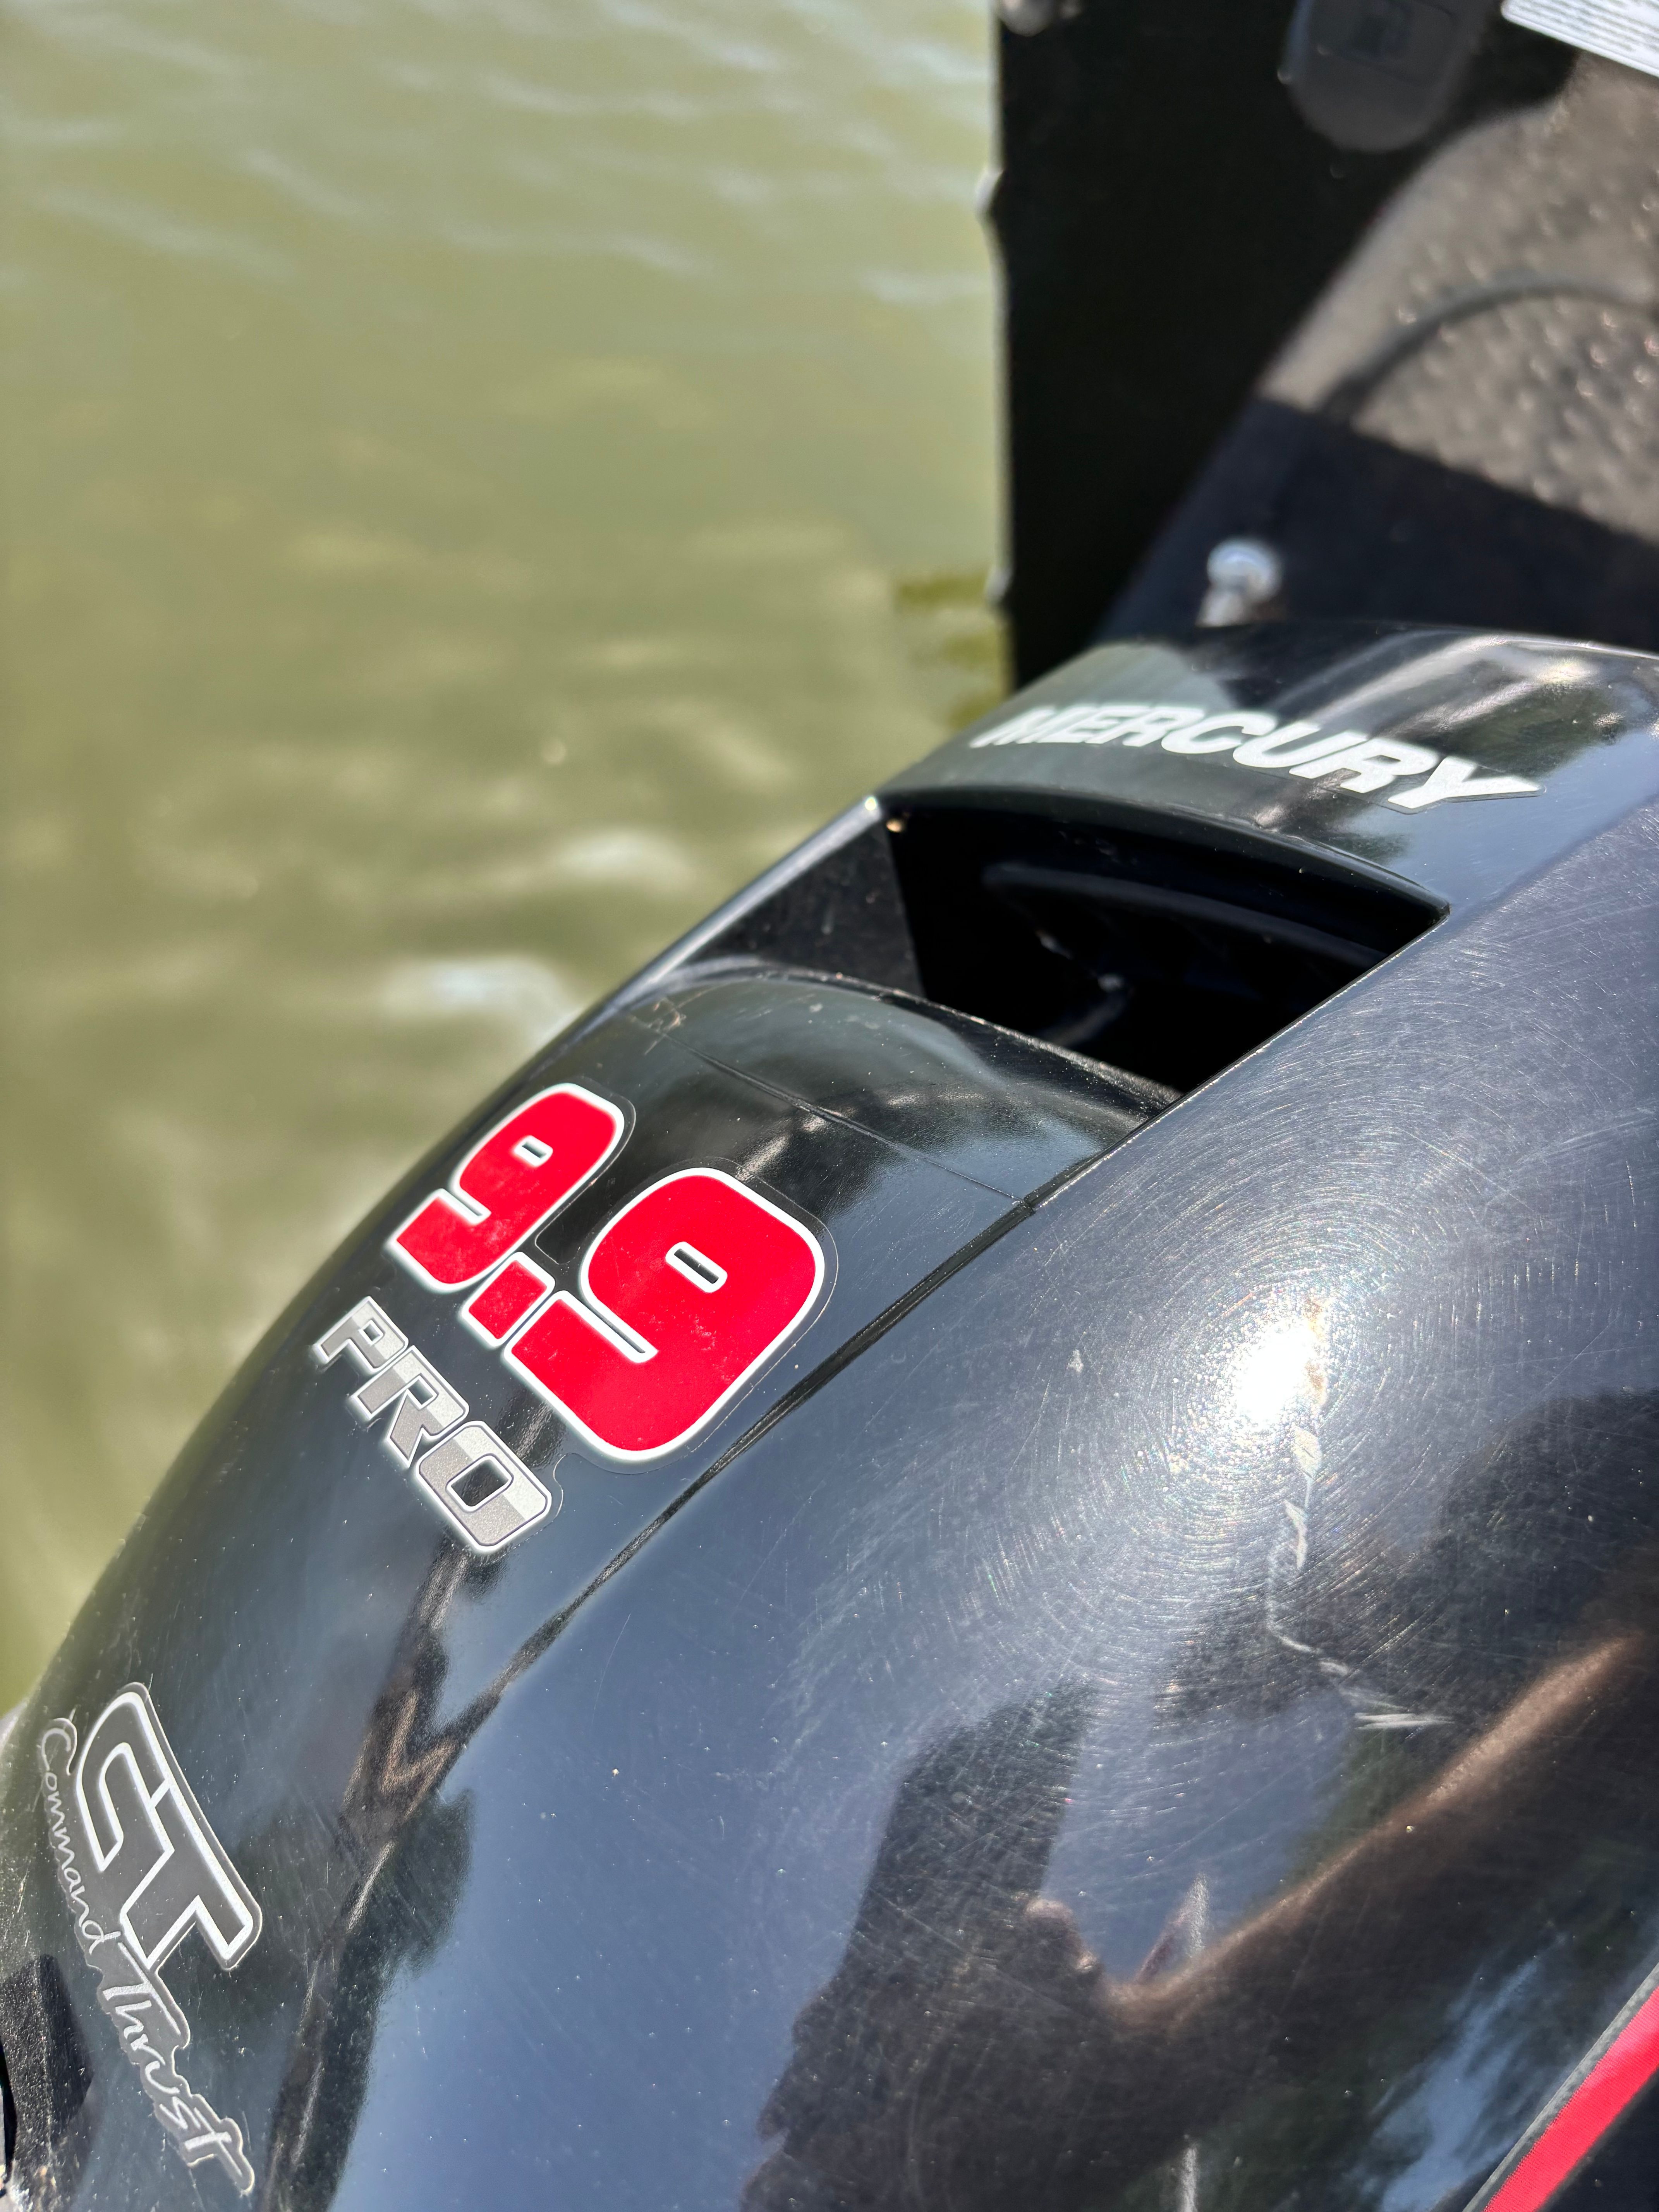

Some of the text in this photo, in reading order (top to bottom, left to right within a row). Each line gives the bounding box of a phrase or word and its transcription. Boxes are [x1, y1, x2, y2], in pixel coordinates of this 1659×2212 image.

[970, 703, 1541, 809] MERCURY
[313, 1296, 552, 1550] PRO
[387, 1083, 825, 1462] 9.9
[40, 1727, 244, 2176] Command Thrust
